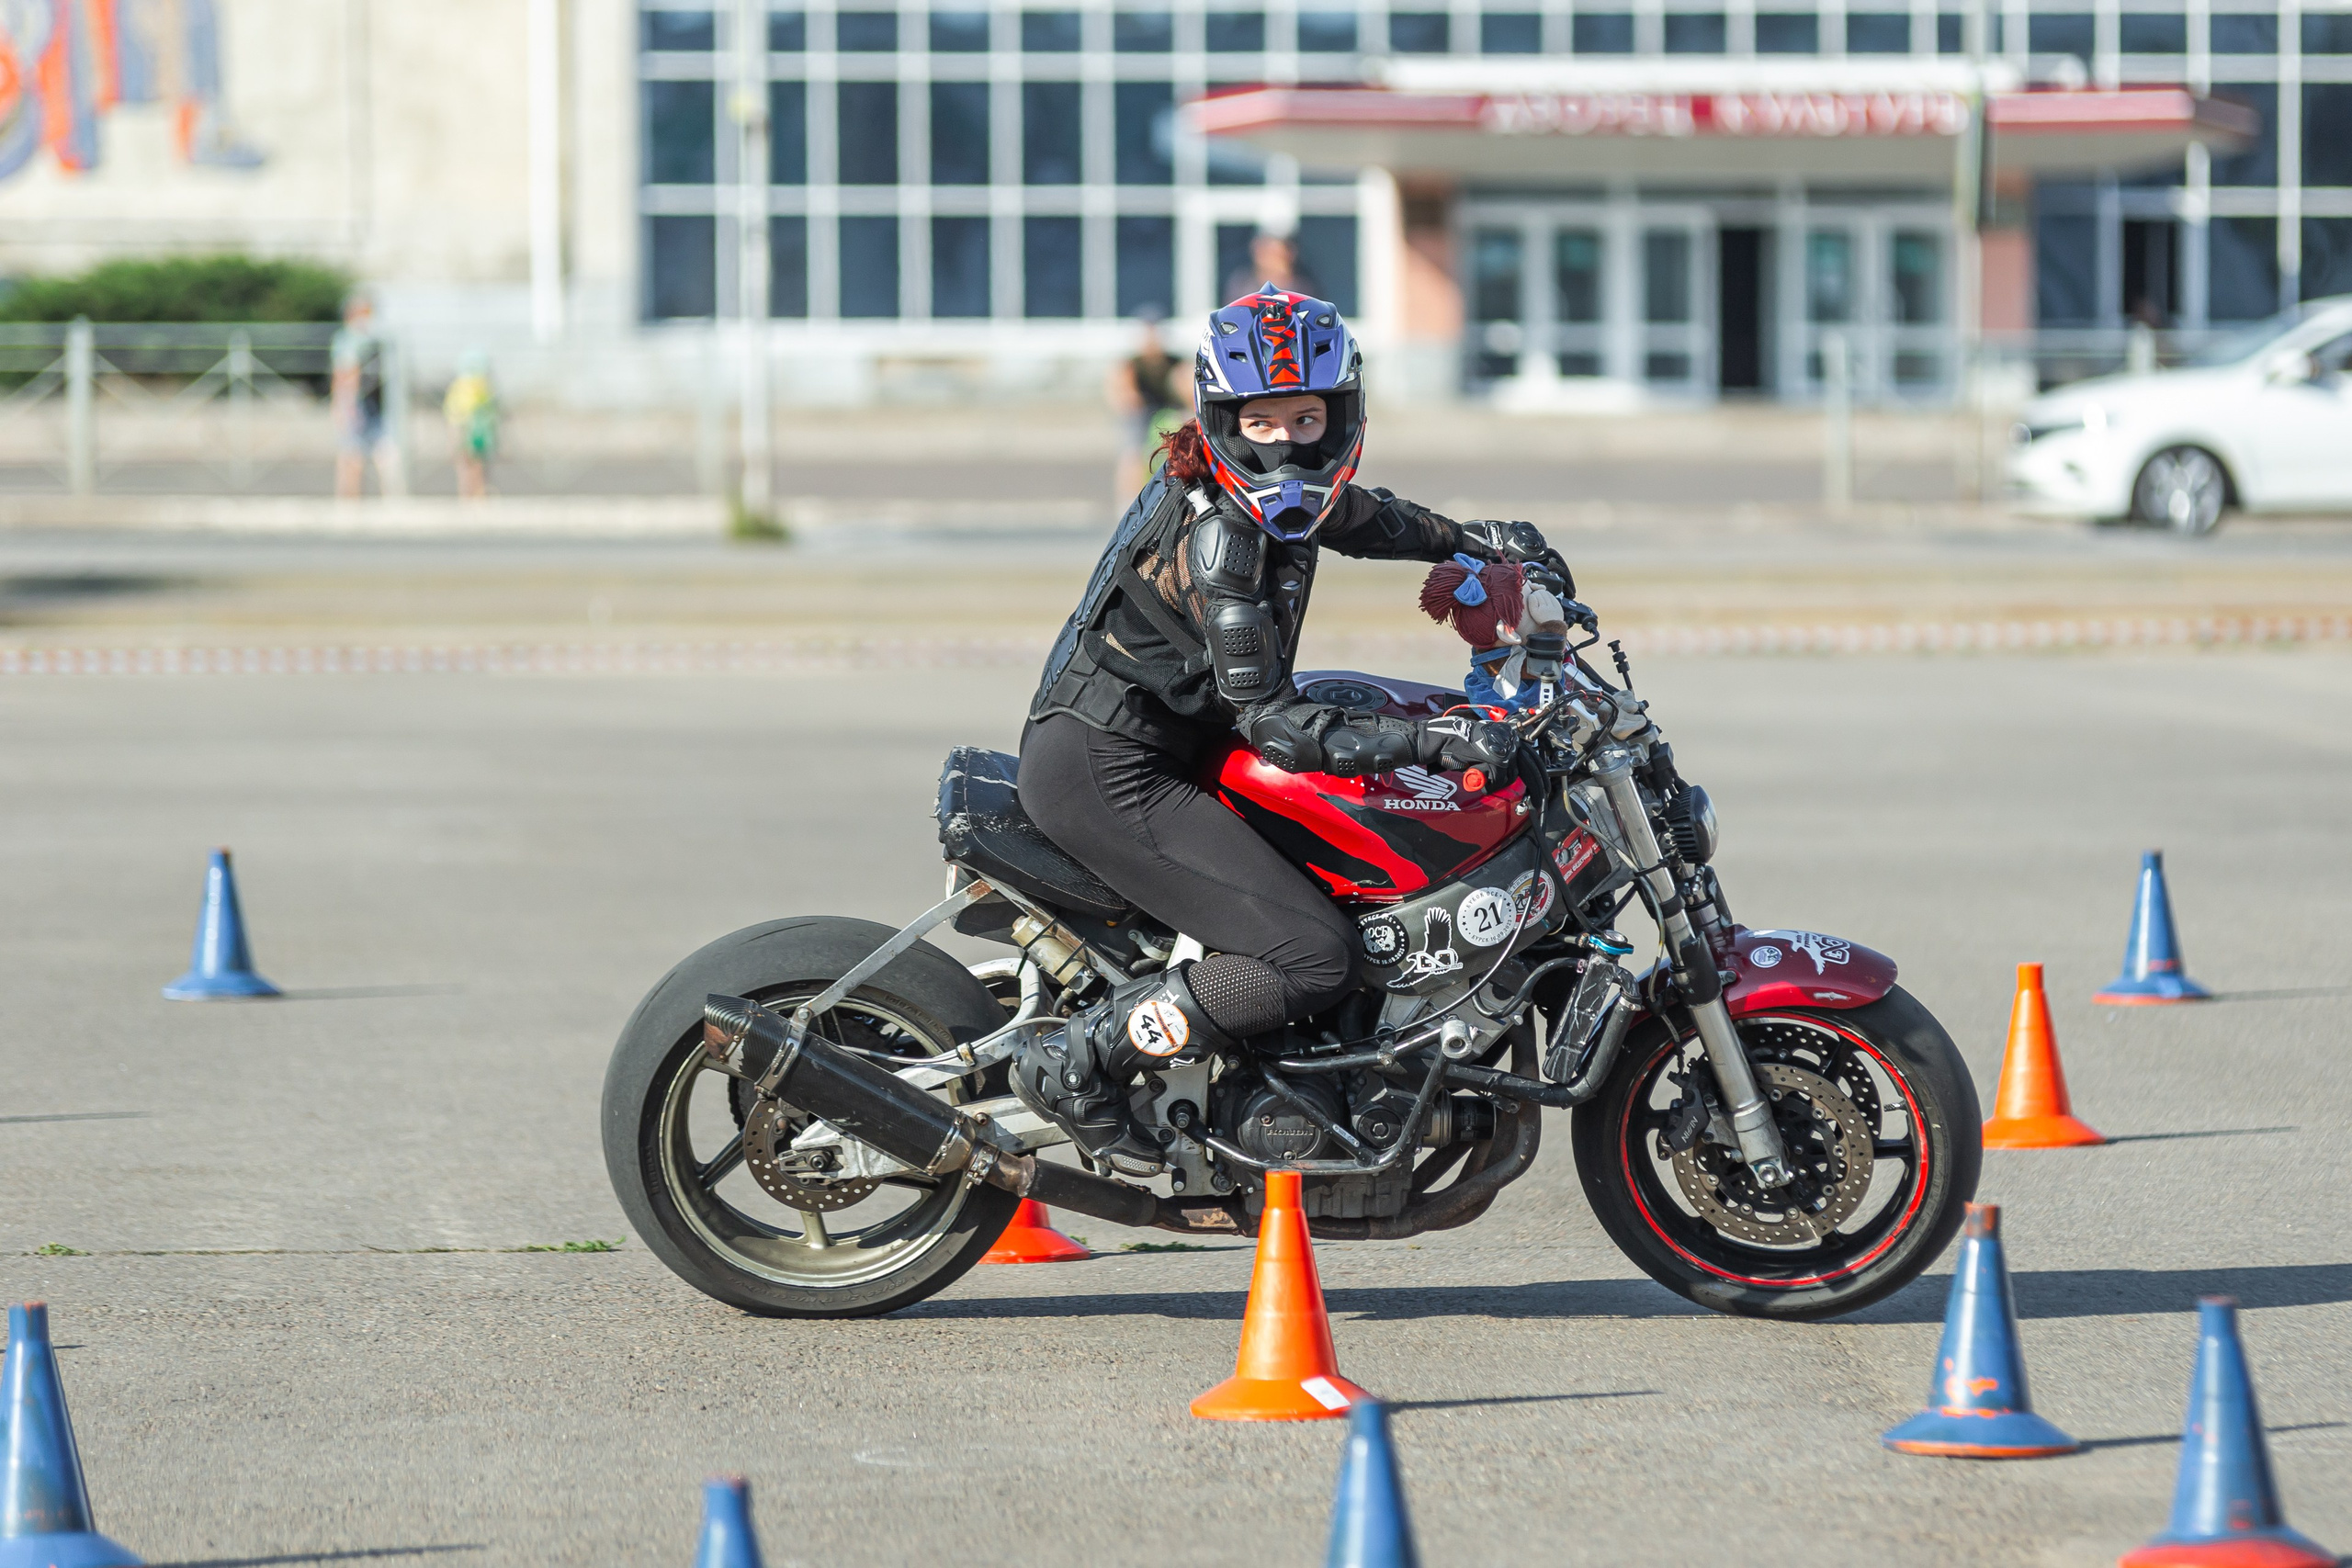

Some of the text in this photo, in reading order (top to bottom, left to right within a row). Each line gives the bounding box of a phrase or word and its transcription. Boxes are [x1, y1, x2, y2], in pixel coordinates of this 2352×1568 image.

[1384, 798, 1461, 811] HONDA
[1474, 901, 1503, 933] 21
[1141, 1014, 1164, 1043] 44
